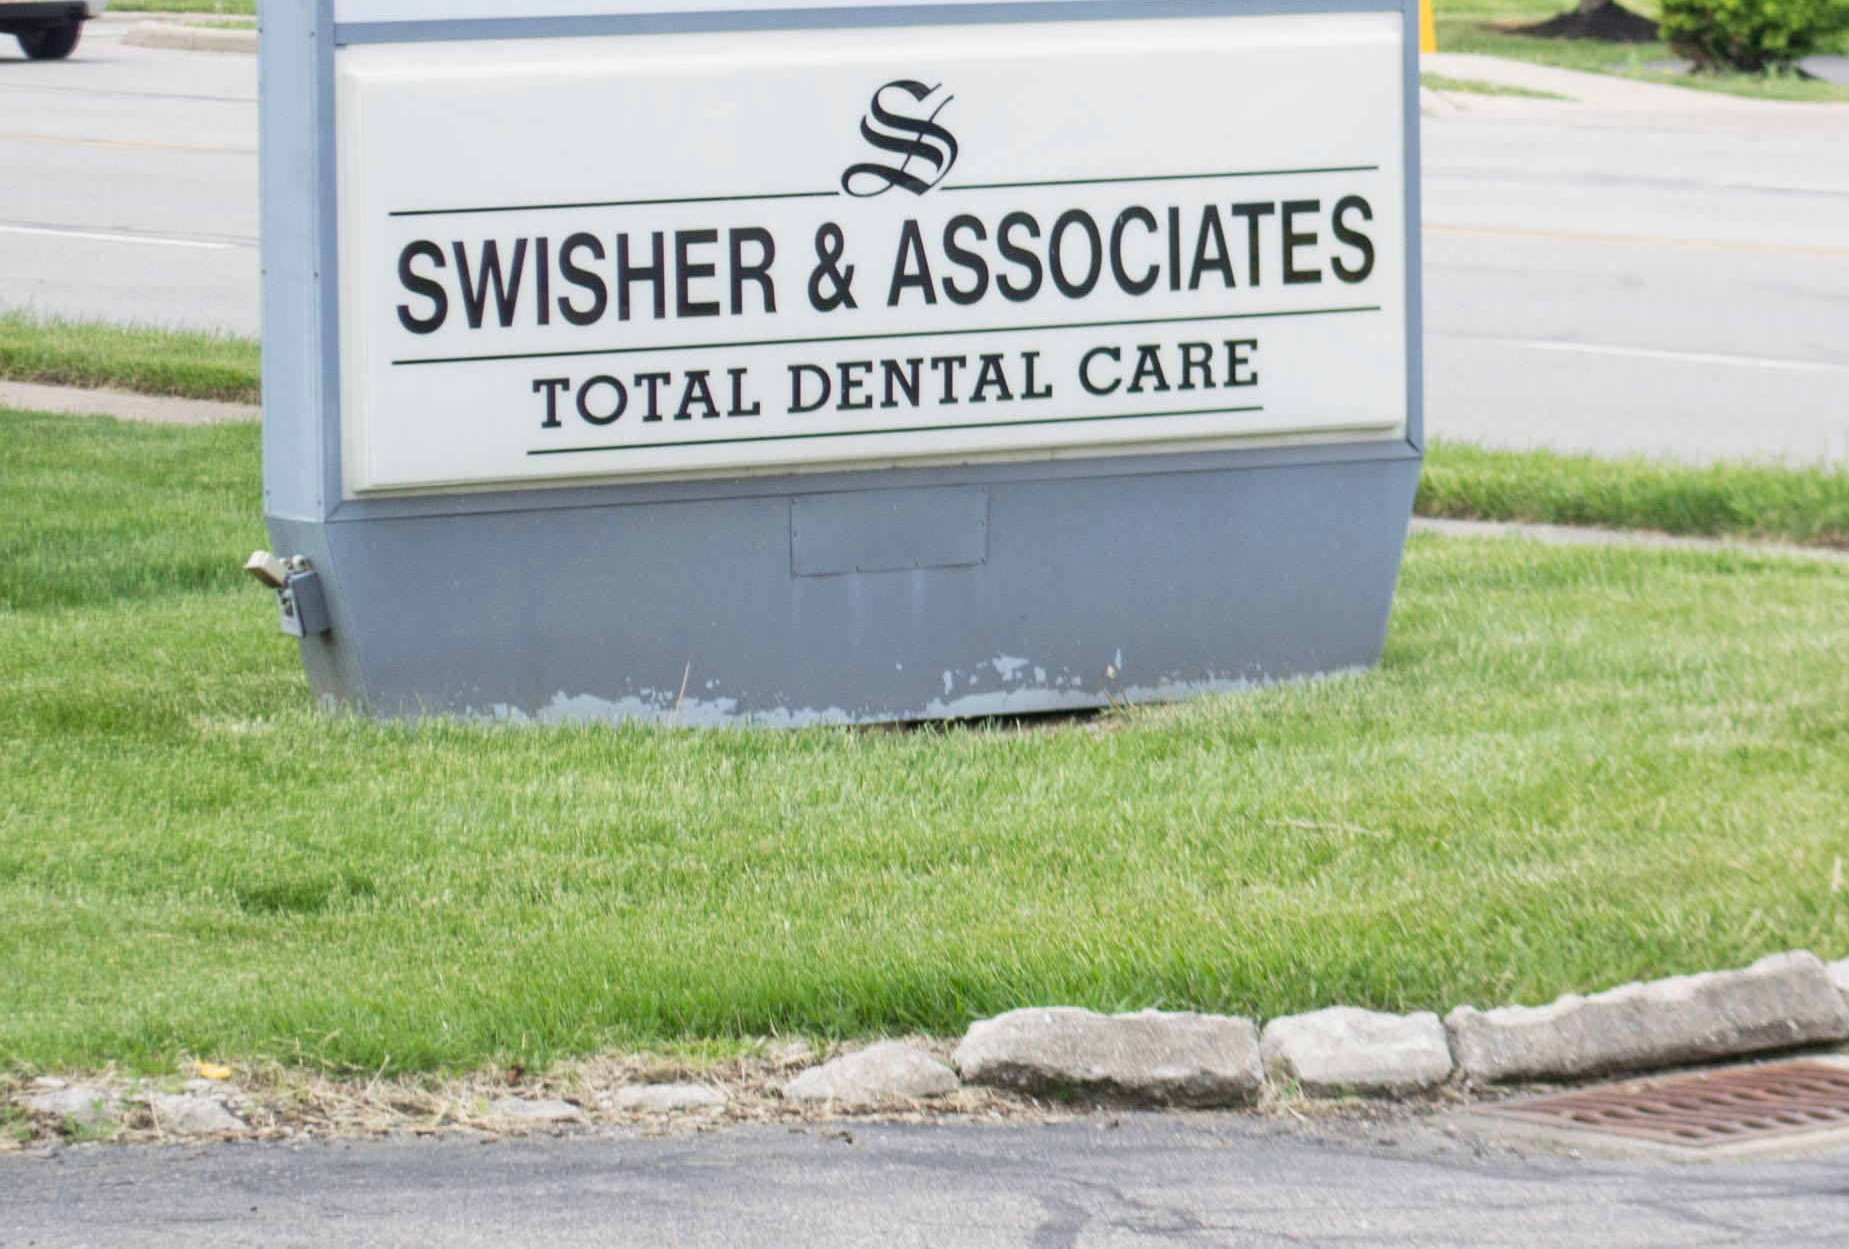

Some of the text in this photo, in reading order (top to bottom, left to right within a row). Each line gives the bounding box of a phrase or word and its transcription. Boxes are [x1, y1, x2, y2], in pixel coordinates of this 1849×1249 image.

[398, 194, 1375, 334] SWISHER & ASSOCIATES
[532, 338, 1258, 429] TOTAL DENTAL CARE
